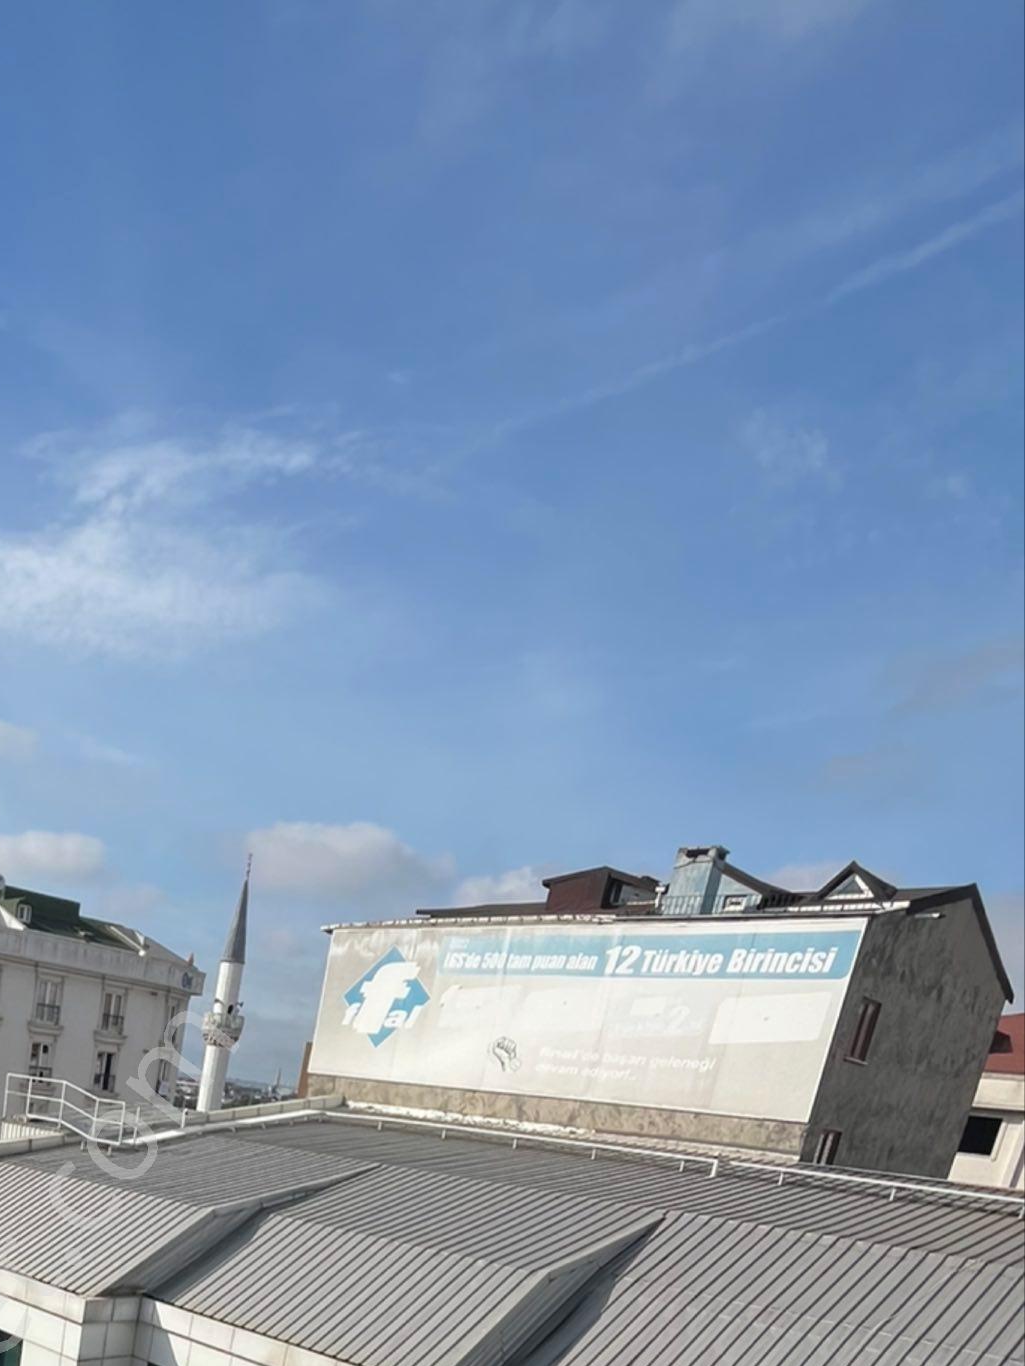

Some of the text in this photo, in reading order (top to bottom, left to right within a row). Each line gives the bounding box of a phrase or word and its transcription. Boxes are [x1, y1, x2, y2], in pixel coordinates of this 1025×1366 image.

[531, 954, 565, 972] puan
[566, 951, 599, 971] alan
[604, 944, 642, 976] 12
[641, 947, 724, 976] Türkiye
[726, 946, 839, 974] Birincisi
